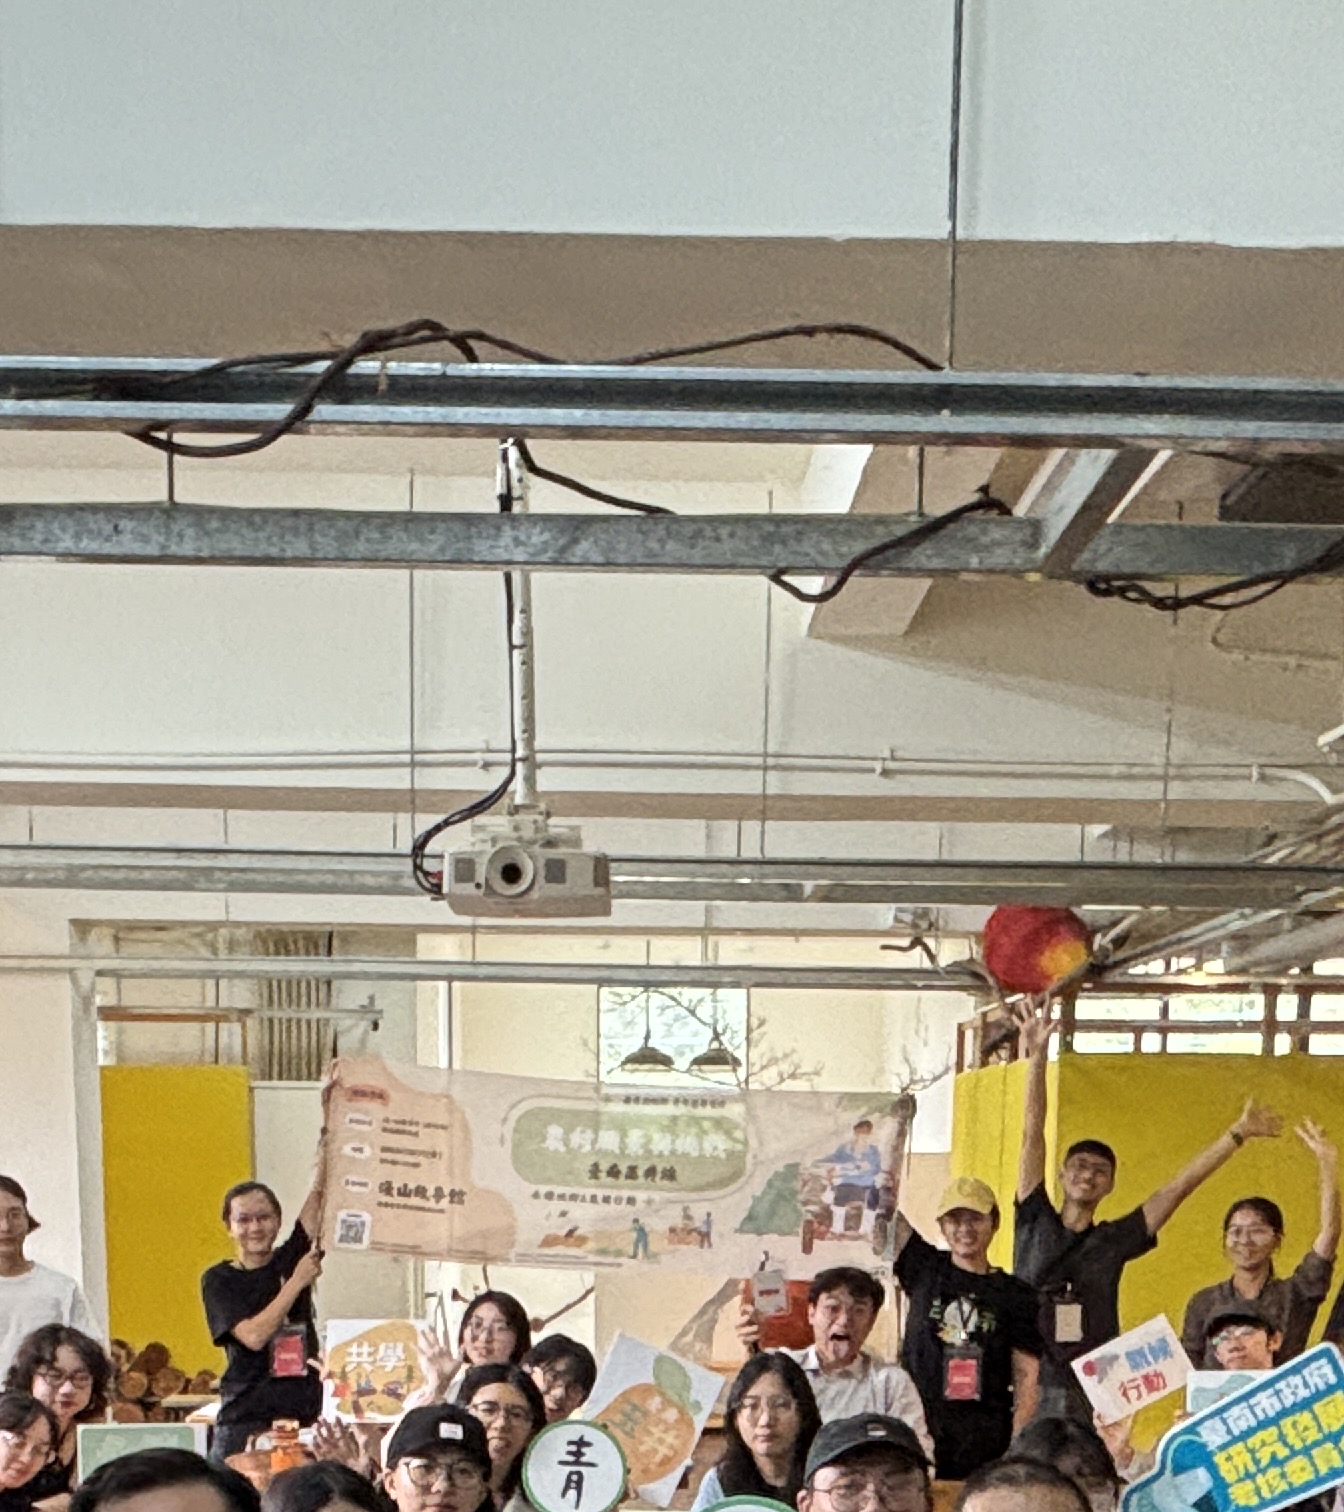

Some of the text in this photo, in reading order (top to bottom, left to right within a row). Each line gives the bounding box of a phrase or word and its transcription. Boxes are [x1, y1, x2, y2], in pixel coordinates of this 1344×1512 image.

[344, 1341, 407, 1373] 共學
[1118, 1369, 1168, 1404] 行動
[557, 1434, 599, 1511] 青
